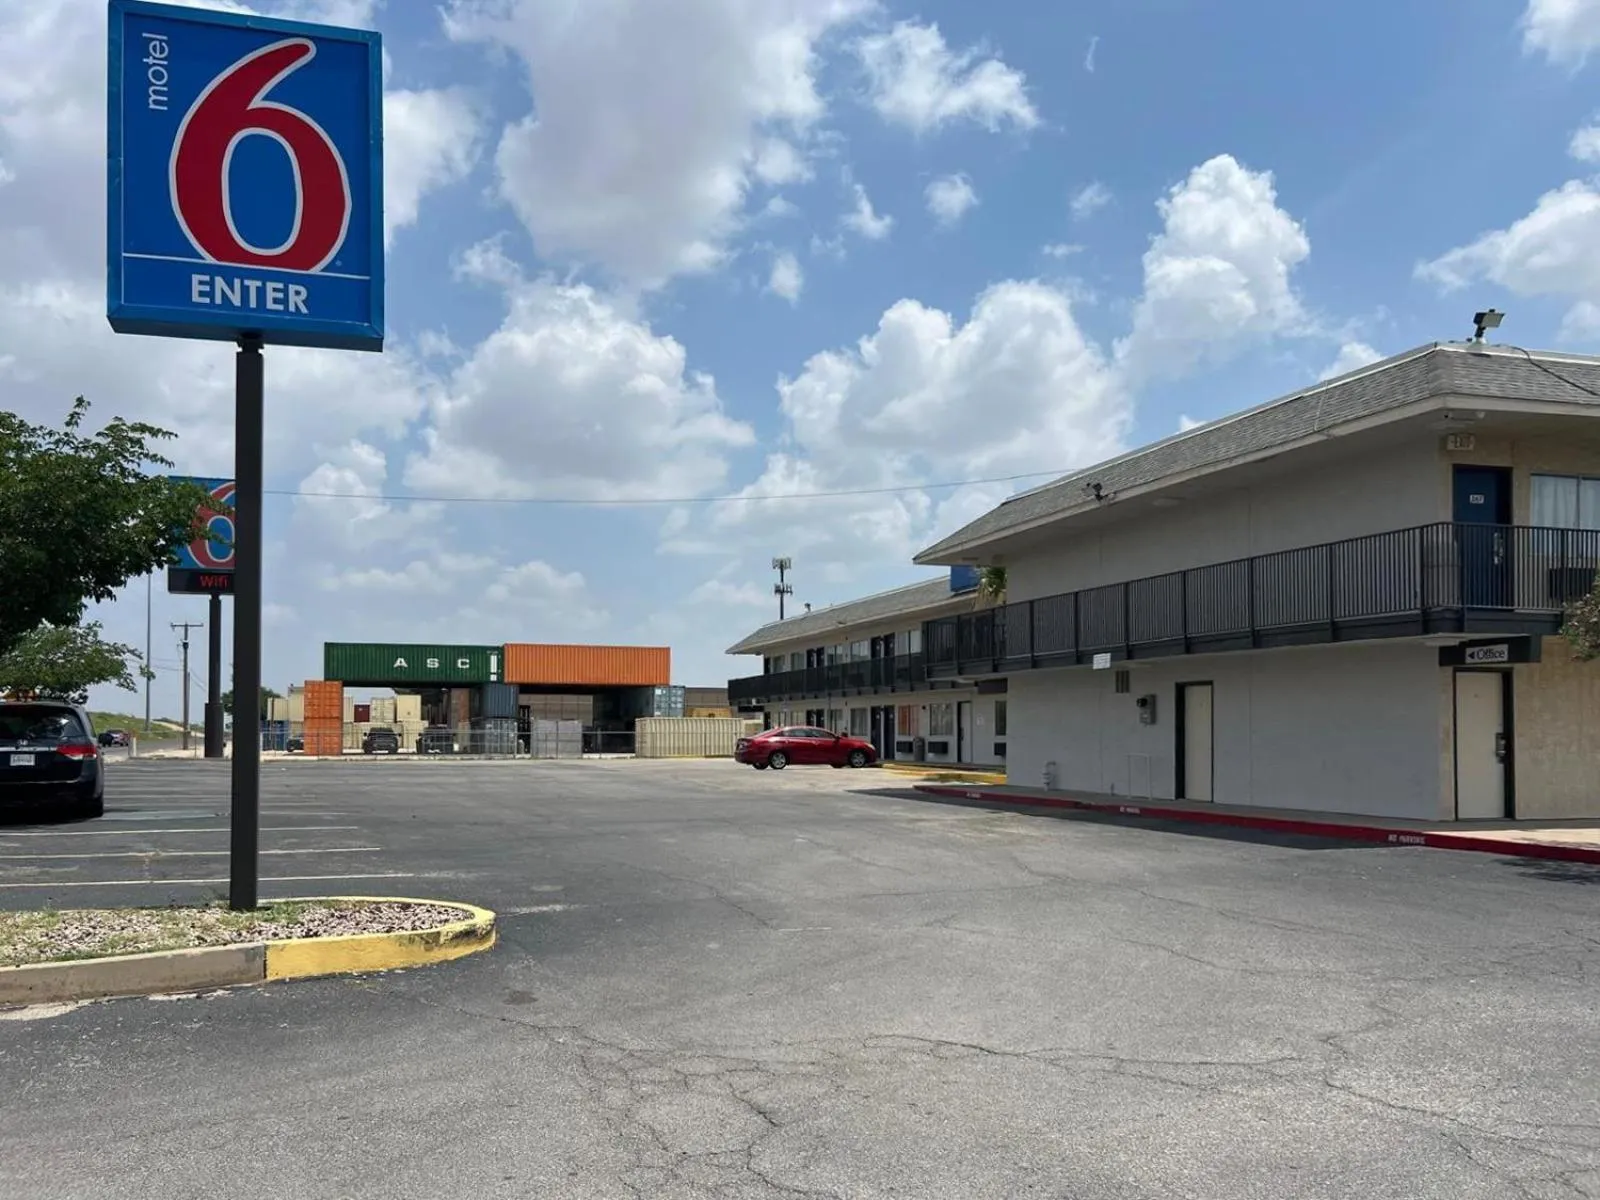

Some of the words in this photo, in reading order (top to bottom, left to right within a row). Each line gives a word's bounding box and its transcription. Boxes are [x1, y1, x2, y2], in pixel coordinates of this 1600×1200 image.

[142, 32, 169, 111] motel
[169, 37, 352, 274] 6
[191, 273, 309, 315] ENTER
[1476, 648, 1505, 661] Office
